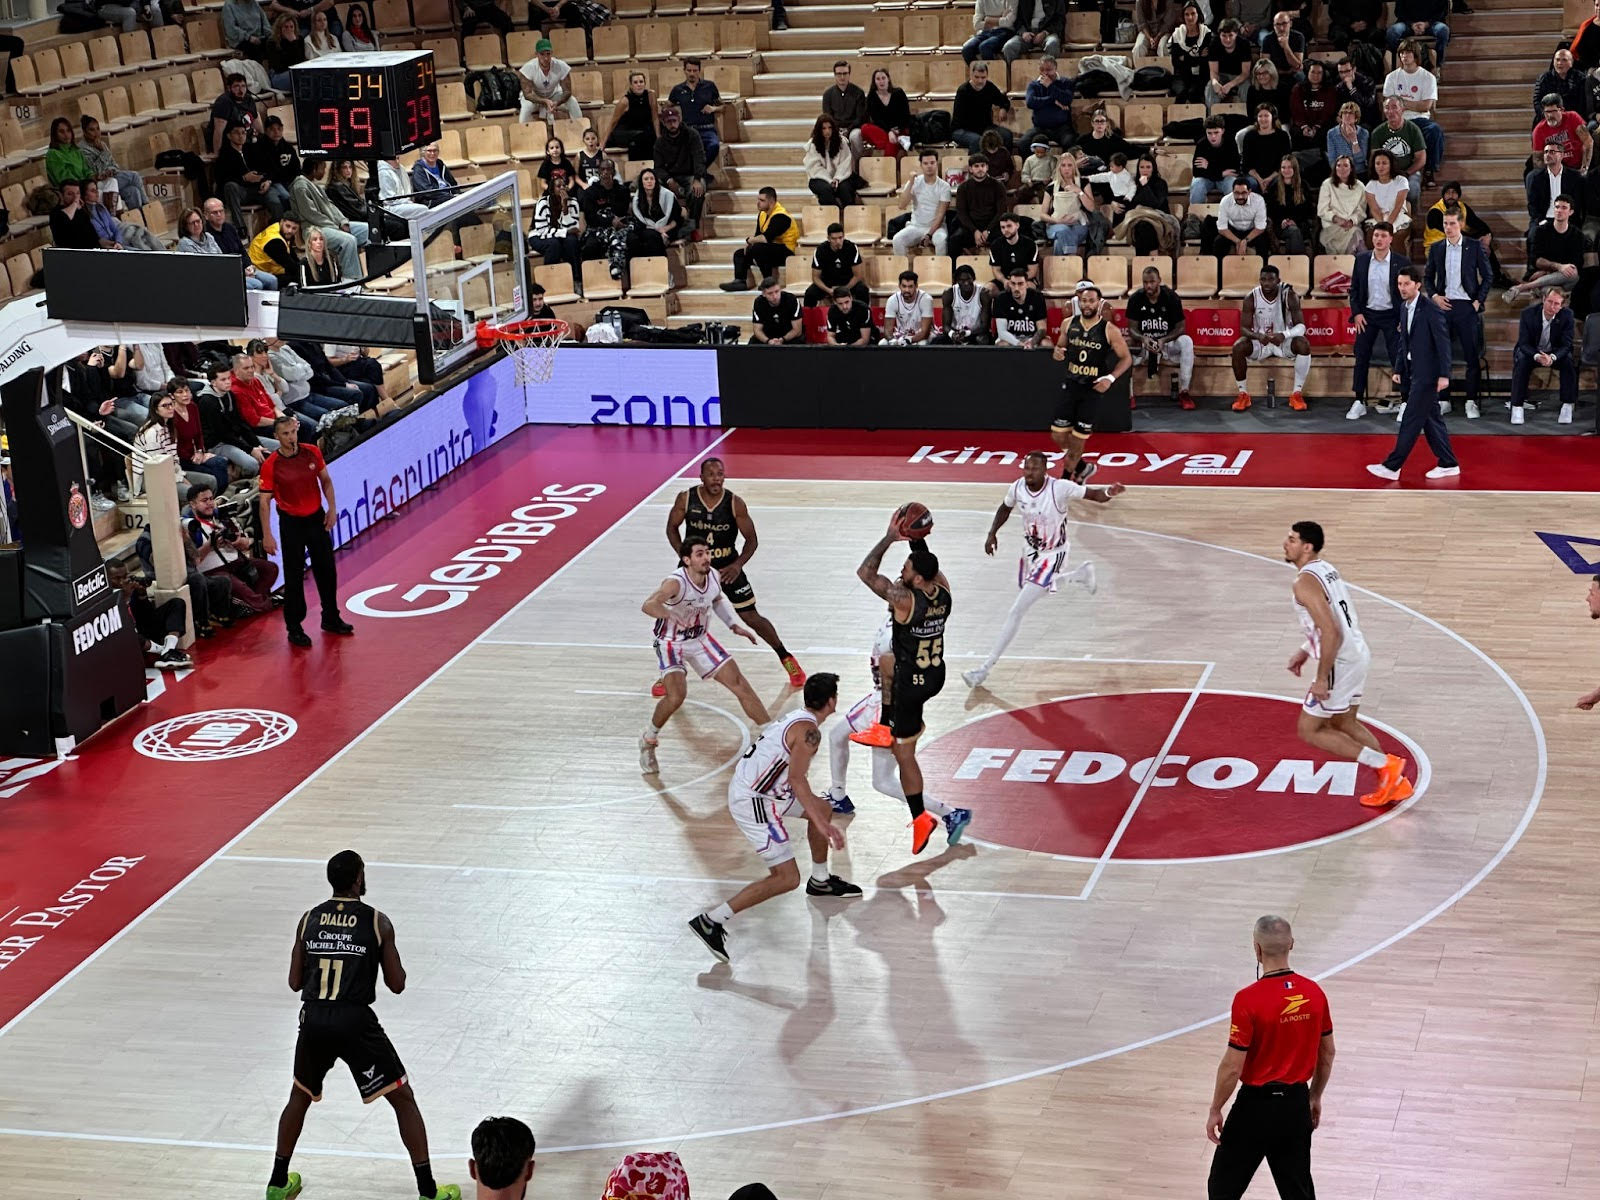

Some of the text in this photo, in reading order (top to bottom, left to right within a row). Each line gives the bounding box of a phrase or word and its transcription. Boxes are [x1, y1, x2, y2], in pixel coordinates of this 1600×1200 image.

[348, 73, 383, 100] 34
[416, 60, 434, 90] 34
[15, 105, 31, 119] 08
[319, 107, 373, 148] 3.9
[152, 183, 168, 197] 06
[0, 340, 34, 375] ALDING
[1078, 350, 1088, 362] 0
[125, 513, 145, 529] 02
[705, 532, 715, 546] 4
[76, 573, 106, 601] Betclic
[72, 604, 123, 656] FEDCOM
[916, 637, 942, 669] 55
[912, 673, 925, 686] 55
[952, 747, 1360, 797] FEDCOM
[10, 855, 147, 929] PASTOR
[320, 913, 358, 928] DIALLO
[318, 958, 344, 1001] 11
[1290, 1013, 1311, 1022] POSTE
